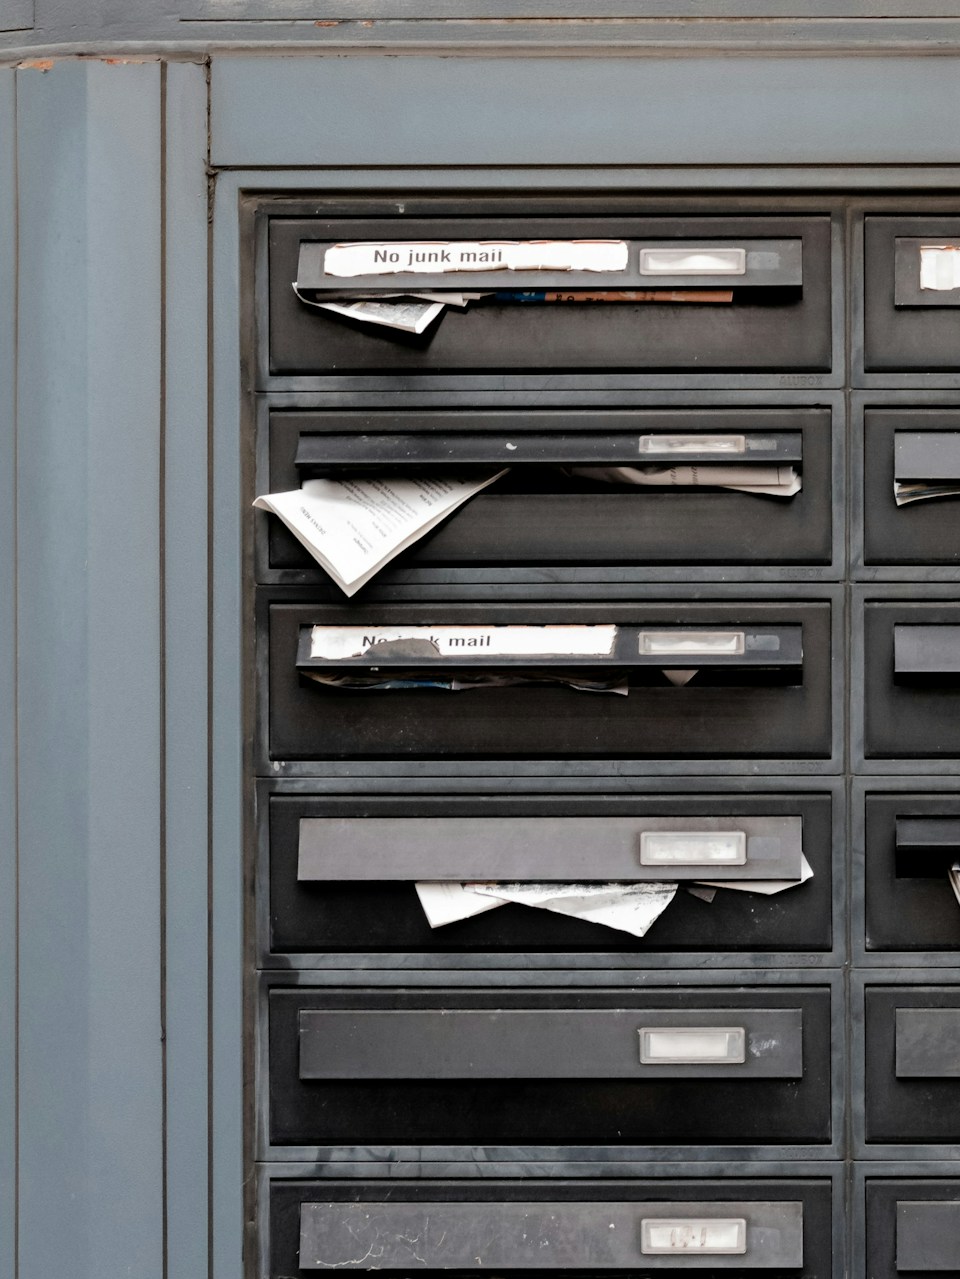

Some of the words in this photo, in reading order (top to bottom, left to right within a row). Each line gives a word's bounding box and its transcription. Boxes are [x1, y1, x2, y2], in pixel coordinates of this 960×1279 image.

[374, 249, 400, 263] No
[408, 249, 451, 266] junk
[460, 249, 503, 263] mail
[449, 635, 492, 647] mail
